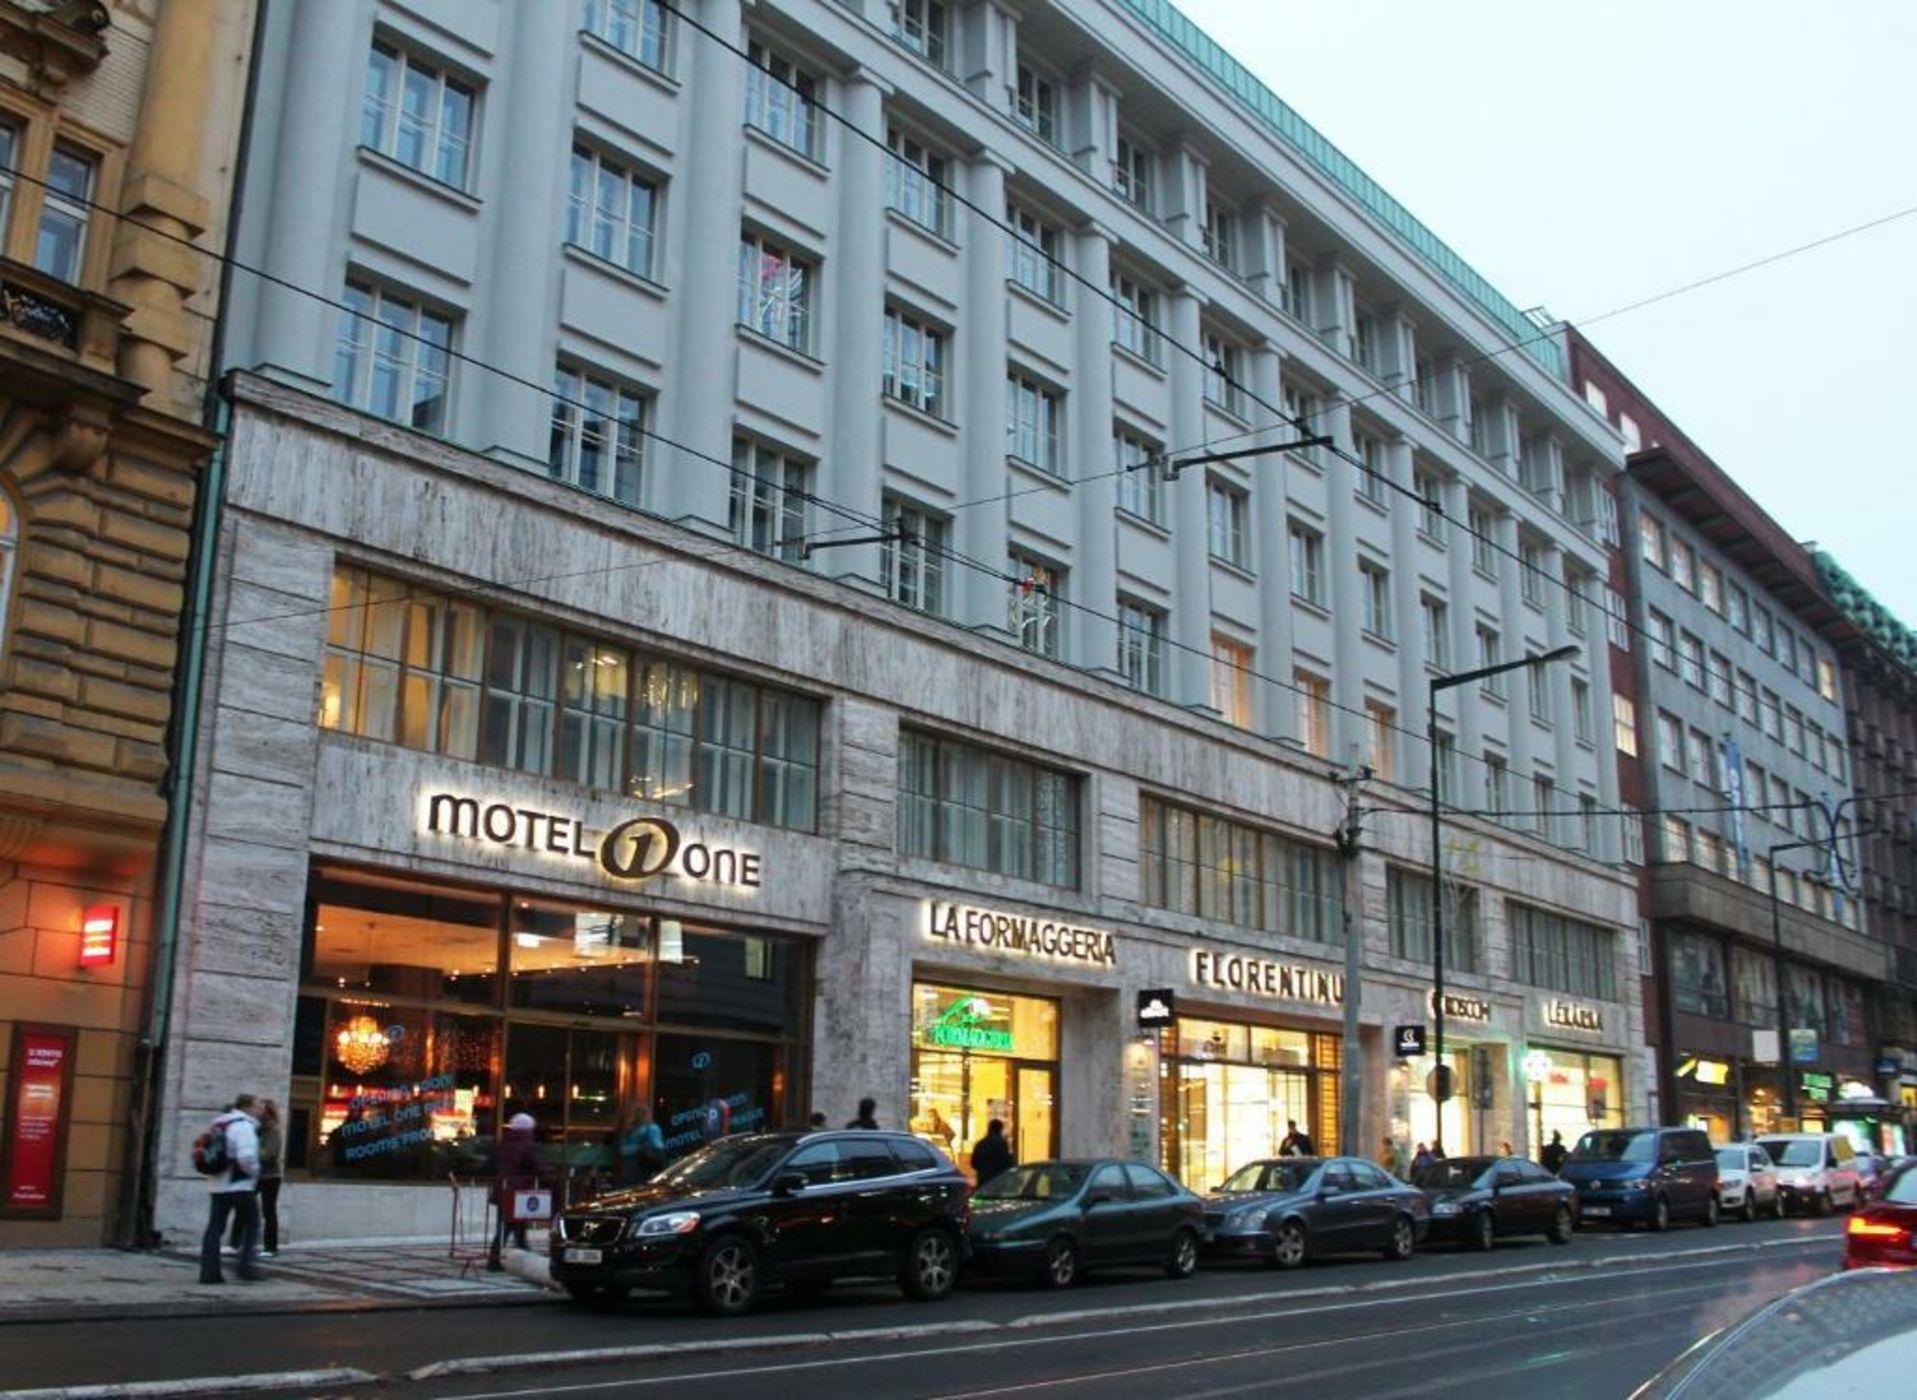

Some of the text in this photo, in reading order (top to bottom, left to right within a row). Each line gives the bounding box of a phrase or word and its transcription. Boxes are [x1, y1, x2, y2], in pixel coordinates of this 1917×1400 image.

[429, 793, 596, 859] MOTEL
[683, 844, 761, 887] ONE
[931, 901, 1116, 964] LA FORMAGGERIA
[1196, 952, 1347, 1003] FLORENTINU
